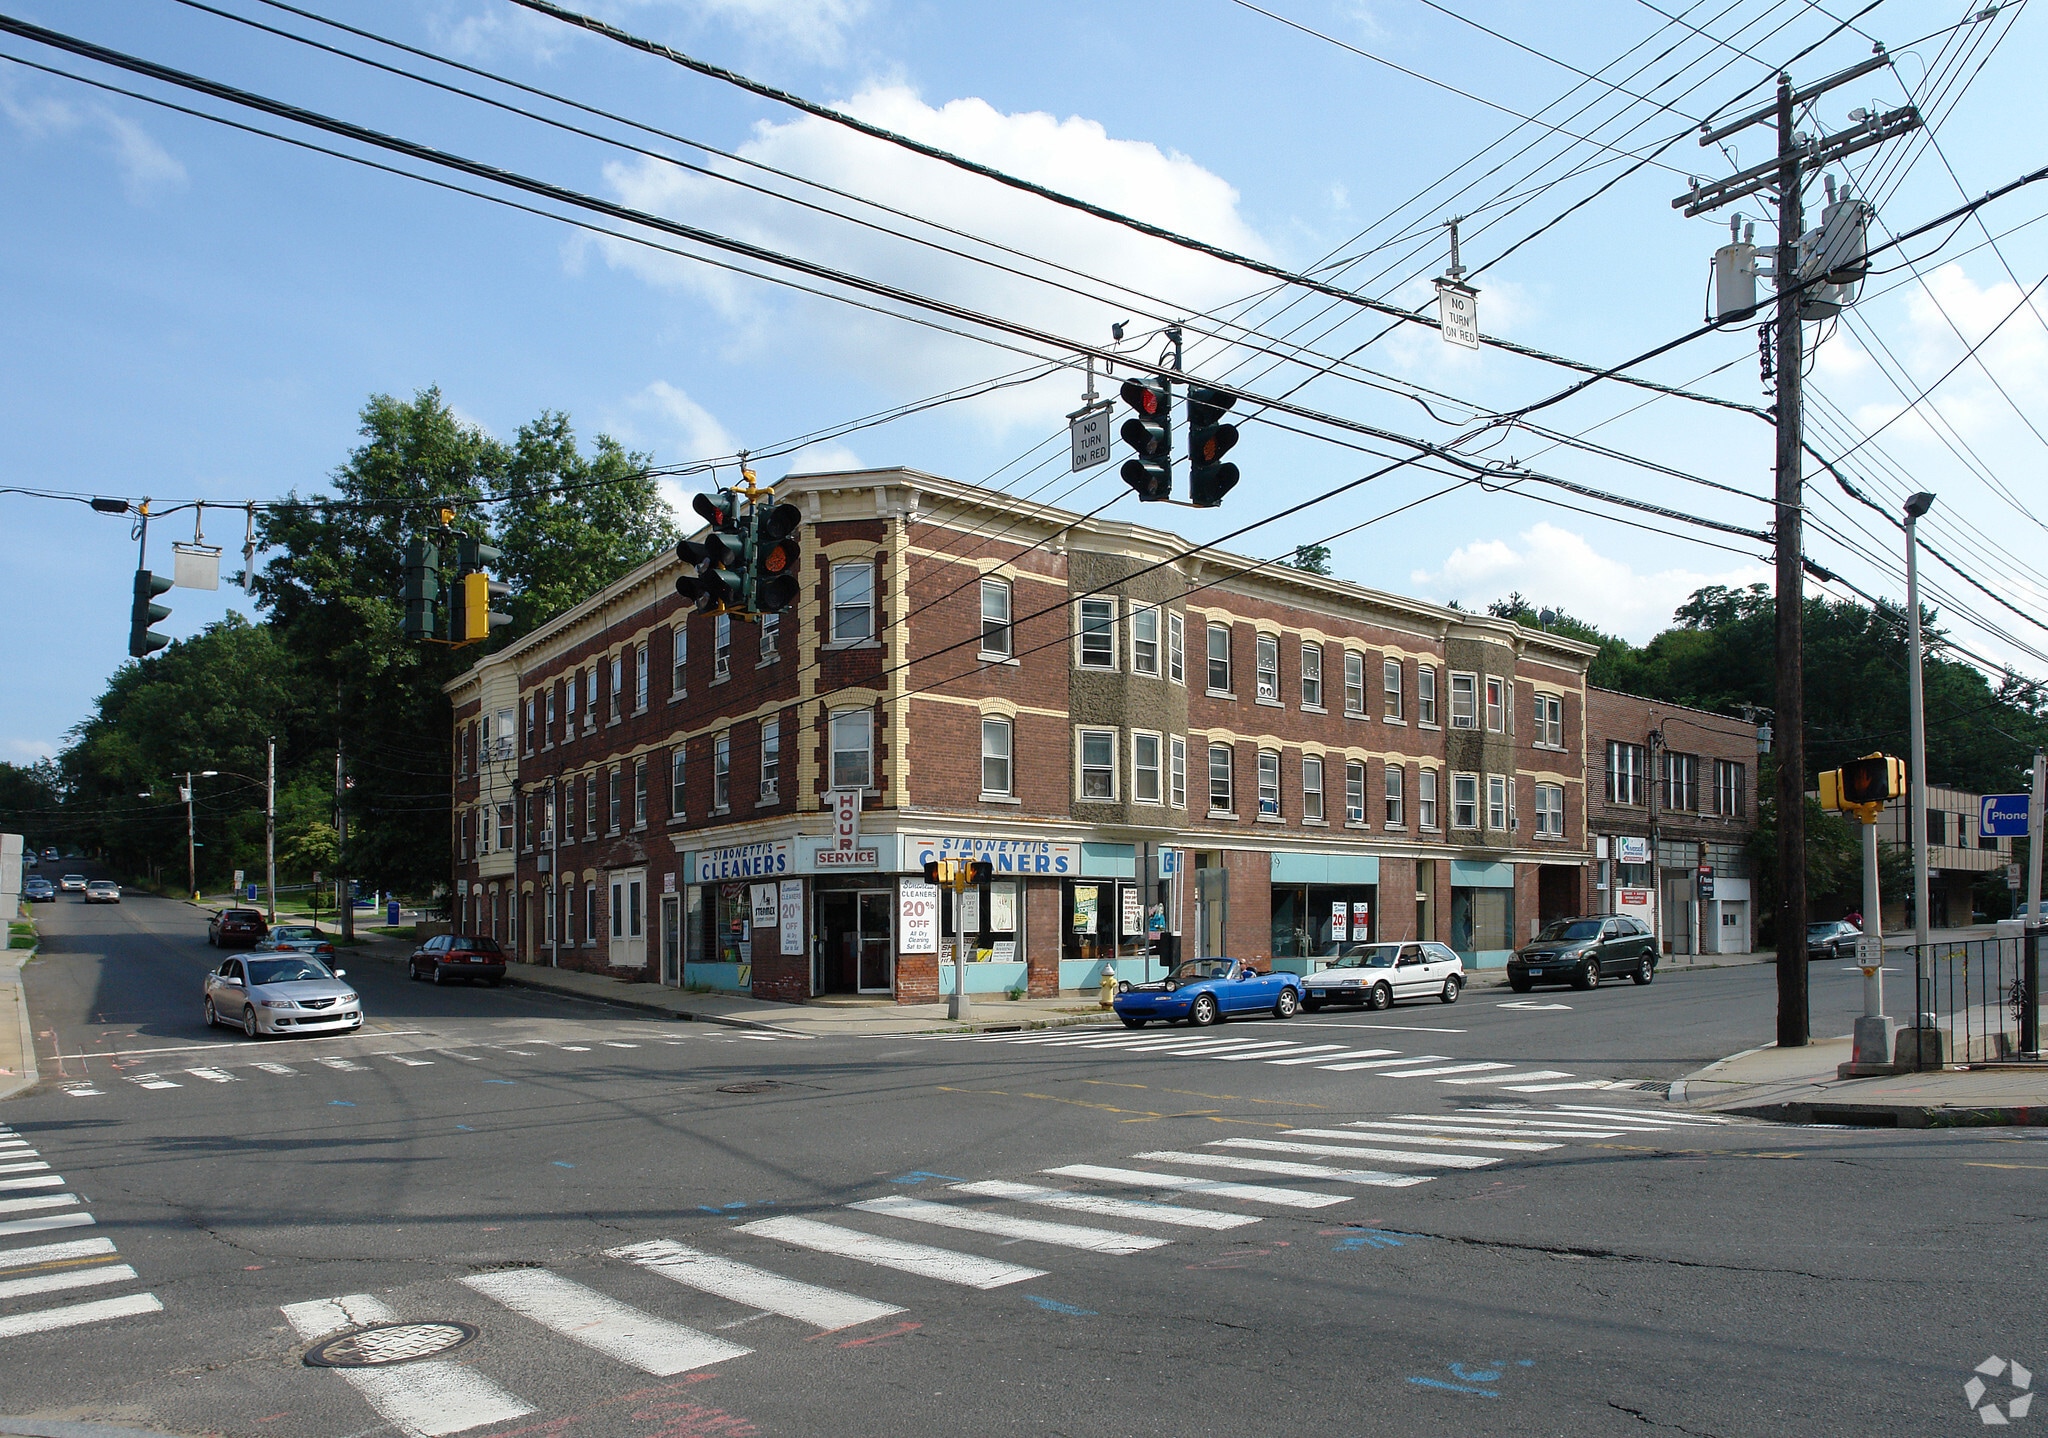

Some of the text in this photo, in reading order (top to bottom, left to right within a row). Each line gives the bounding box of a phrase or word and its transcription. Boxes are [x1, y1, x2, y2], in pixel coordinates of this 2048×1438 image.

[1452, 298, 1464, 310] NO
[1449, 312, 1469, 327] TURN
[1446, 326, 1475, 343] ON RED
[1084, 422, 1097, 434] NO
[1081, 434, 1101, 449] TURN
[1076, 447, 1106, 465] ON RED
[839, 795, 853, 850] HOUR
[1992, 811, 2028, 820] Phone
[713, 843, 773, 861] SIMONETTI'S
[819, 852, 874, 863] SERVICE
[702, 853, 786, 880] CLEANERS
[782, 903, 801, 918] 20%
[903, 900, 935, 916] 20%
[785, 922, 798, 930] OFF
[908, 920, 930, 928] OFF
